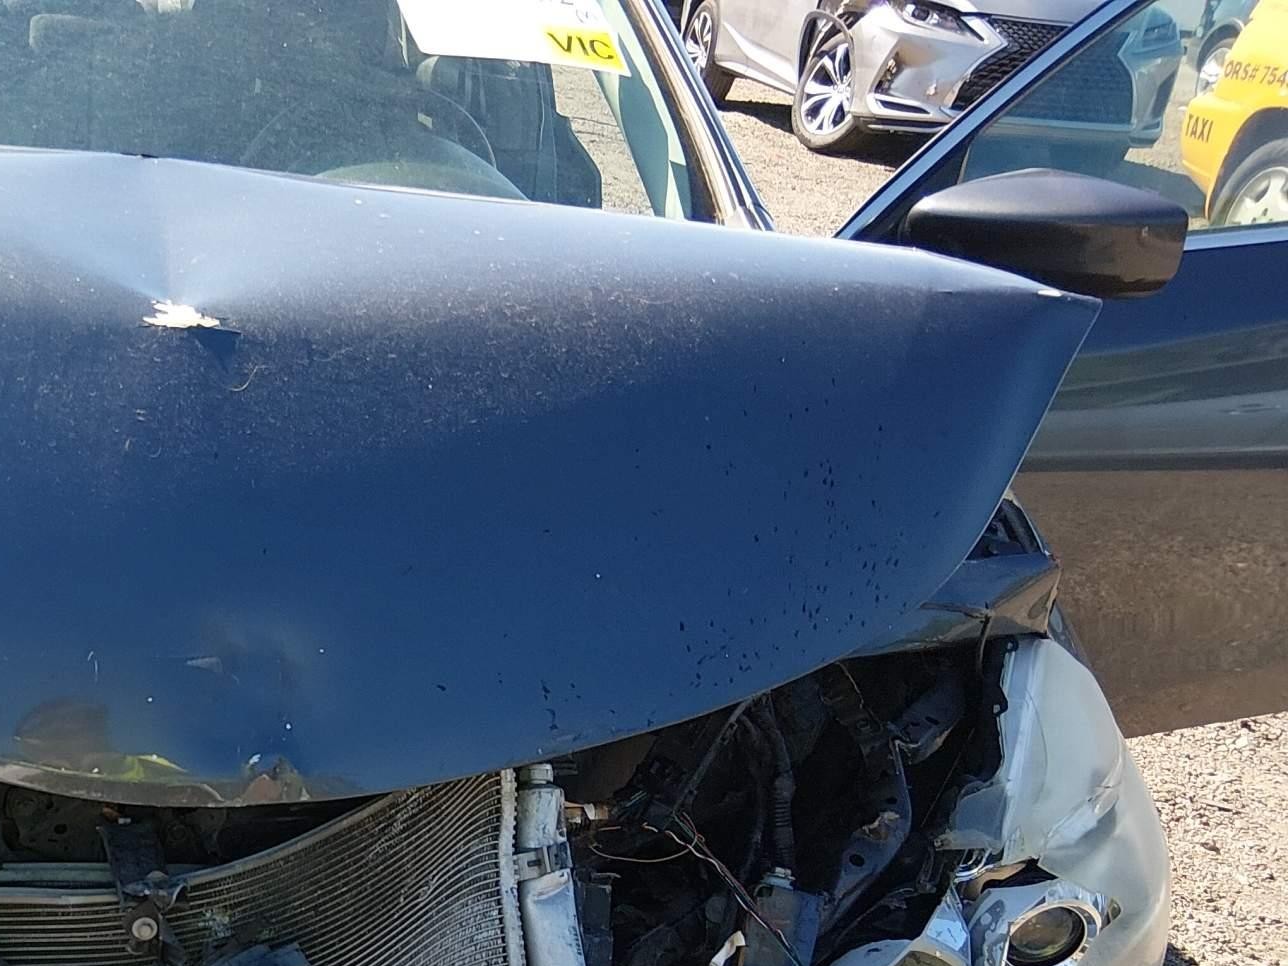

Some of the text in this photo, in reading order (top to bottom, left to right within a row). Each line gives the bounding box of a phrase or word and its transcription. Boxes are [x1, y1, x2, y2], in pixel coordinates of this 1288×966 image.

[546, 31, 616, 61] VIC
[1259, 65, 1288, 88] 754
[1185, 113, 1214, 143] TAXI
